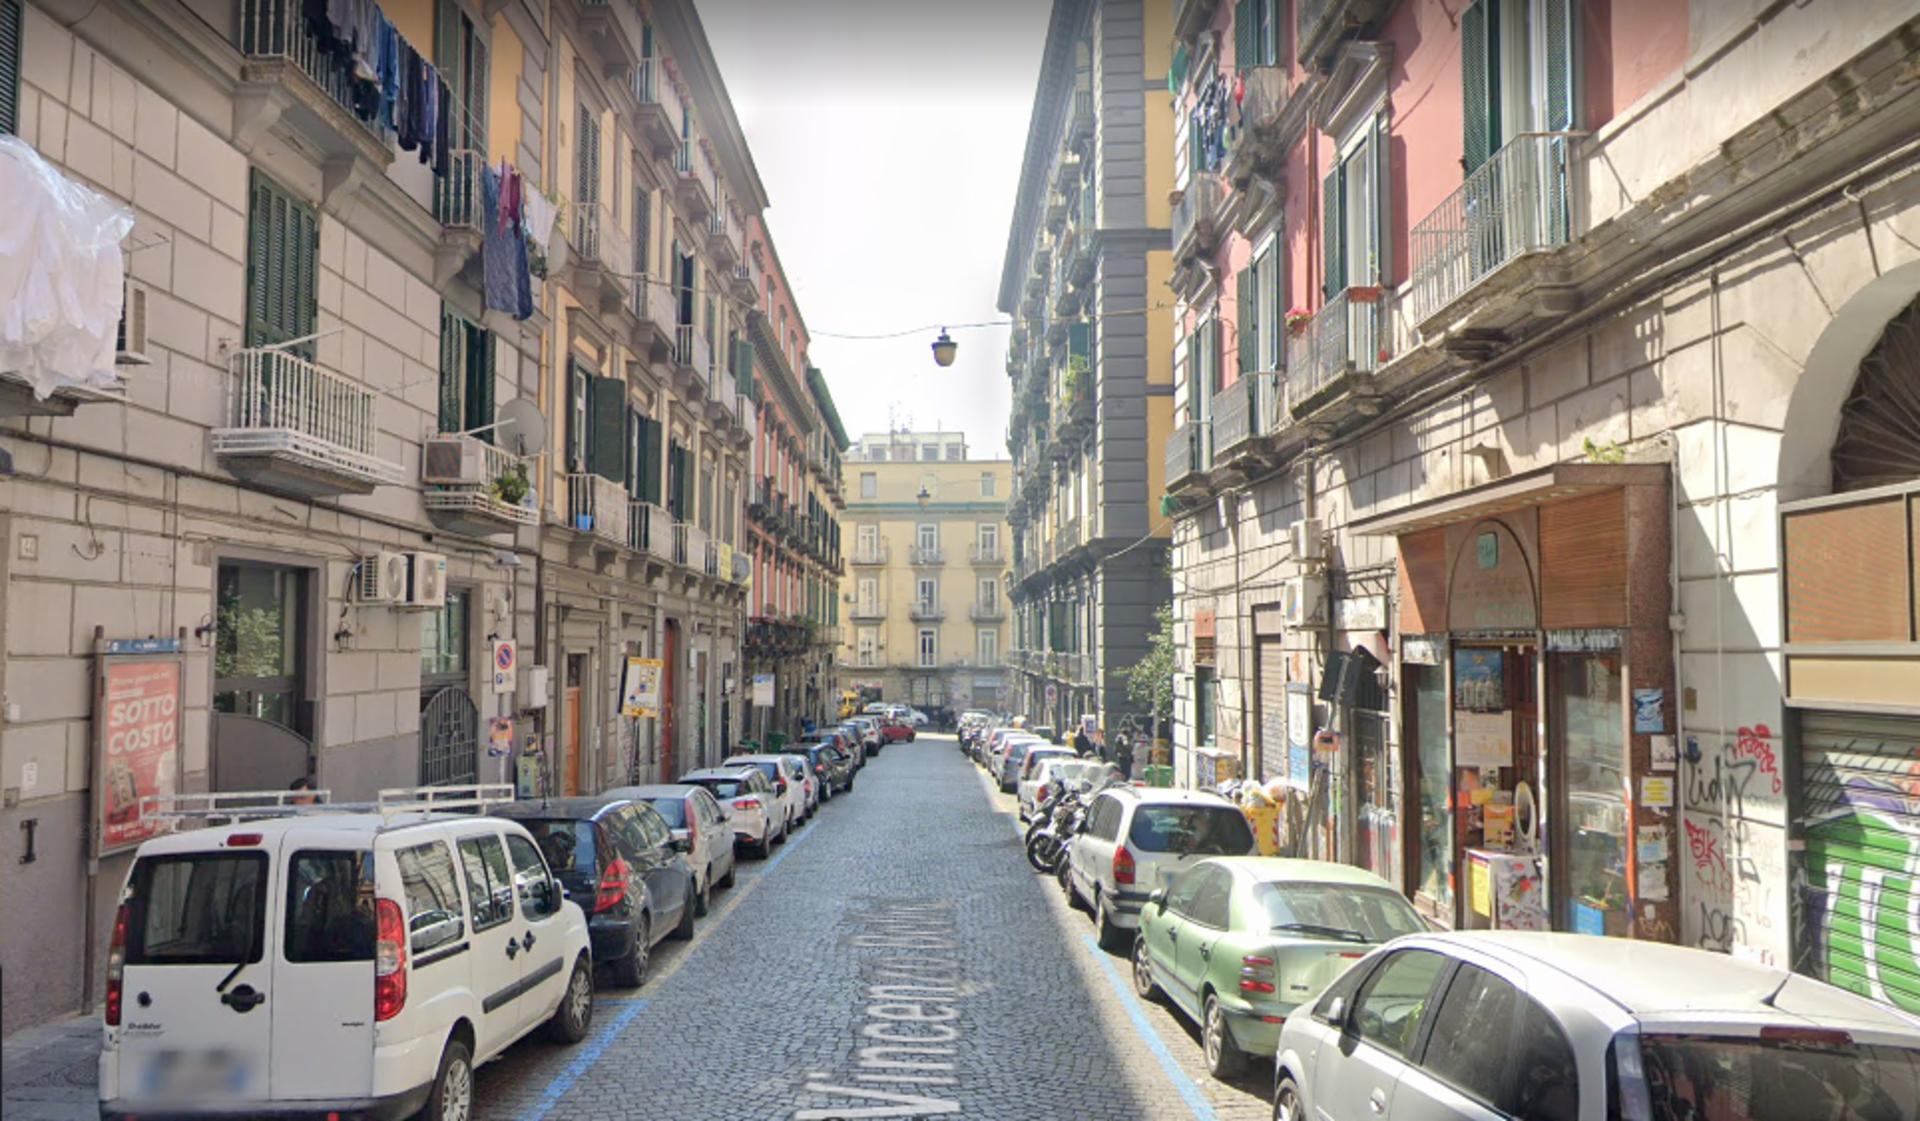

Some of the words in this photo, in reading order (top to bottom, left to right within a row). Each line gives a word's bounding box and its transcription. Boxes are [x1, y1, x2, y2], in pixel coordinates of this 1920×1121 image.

[109, 694, 176, 728] SOTTO
[108, 722, 175, 756] COSTO
[793, 955, 962, 1121] Vincenzo
